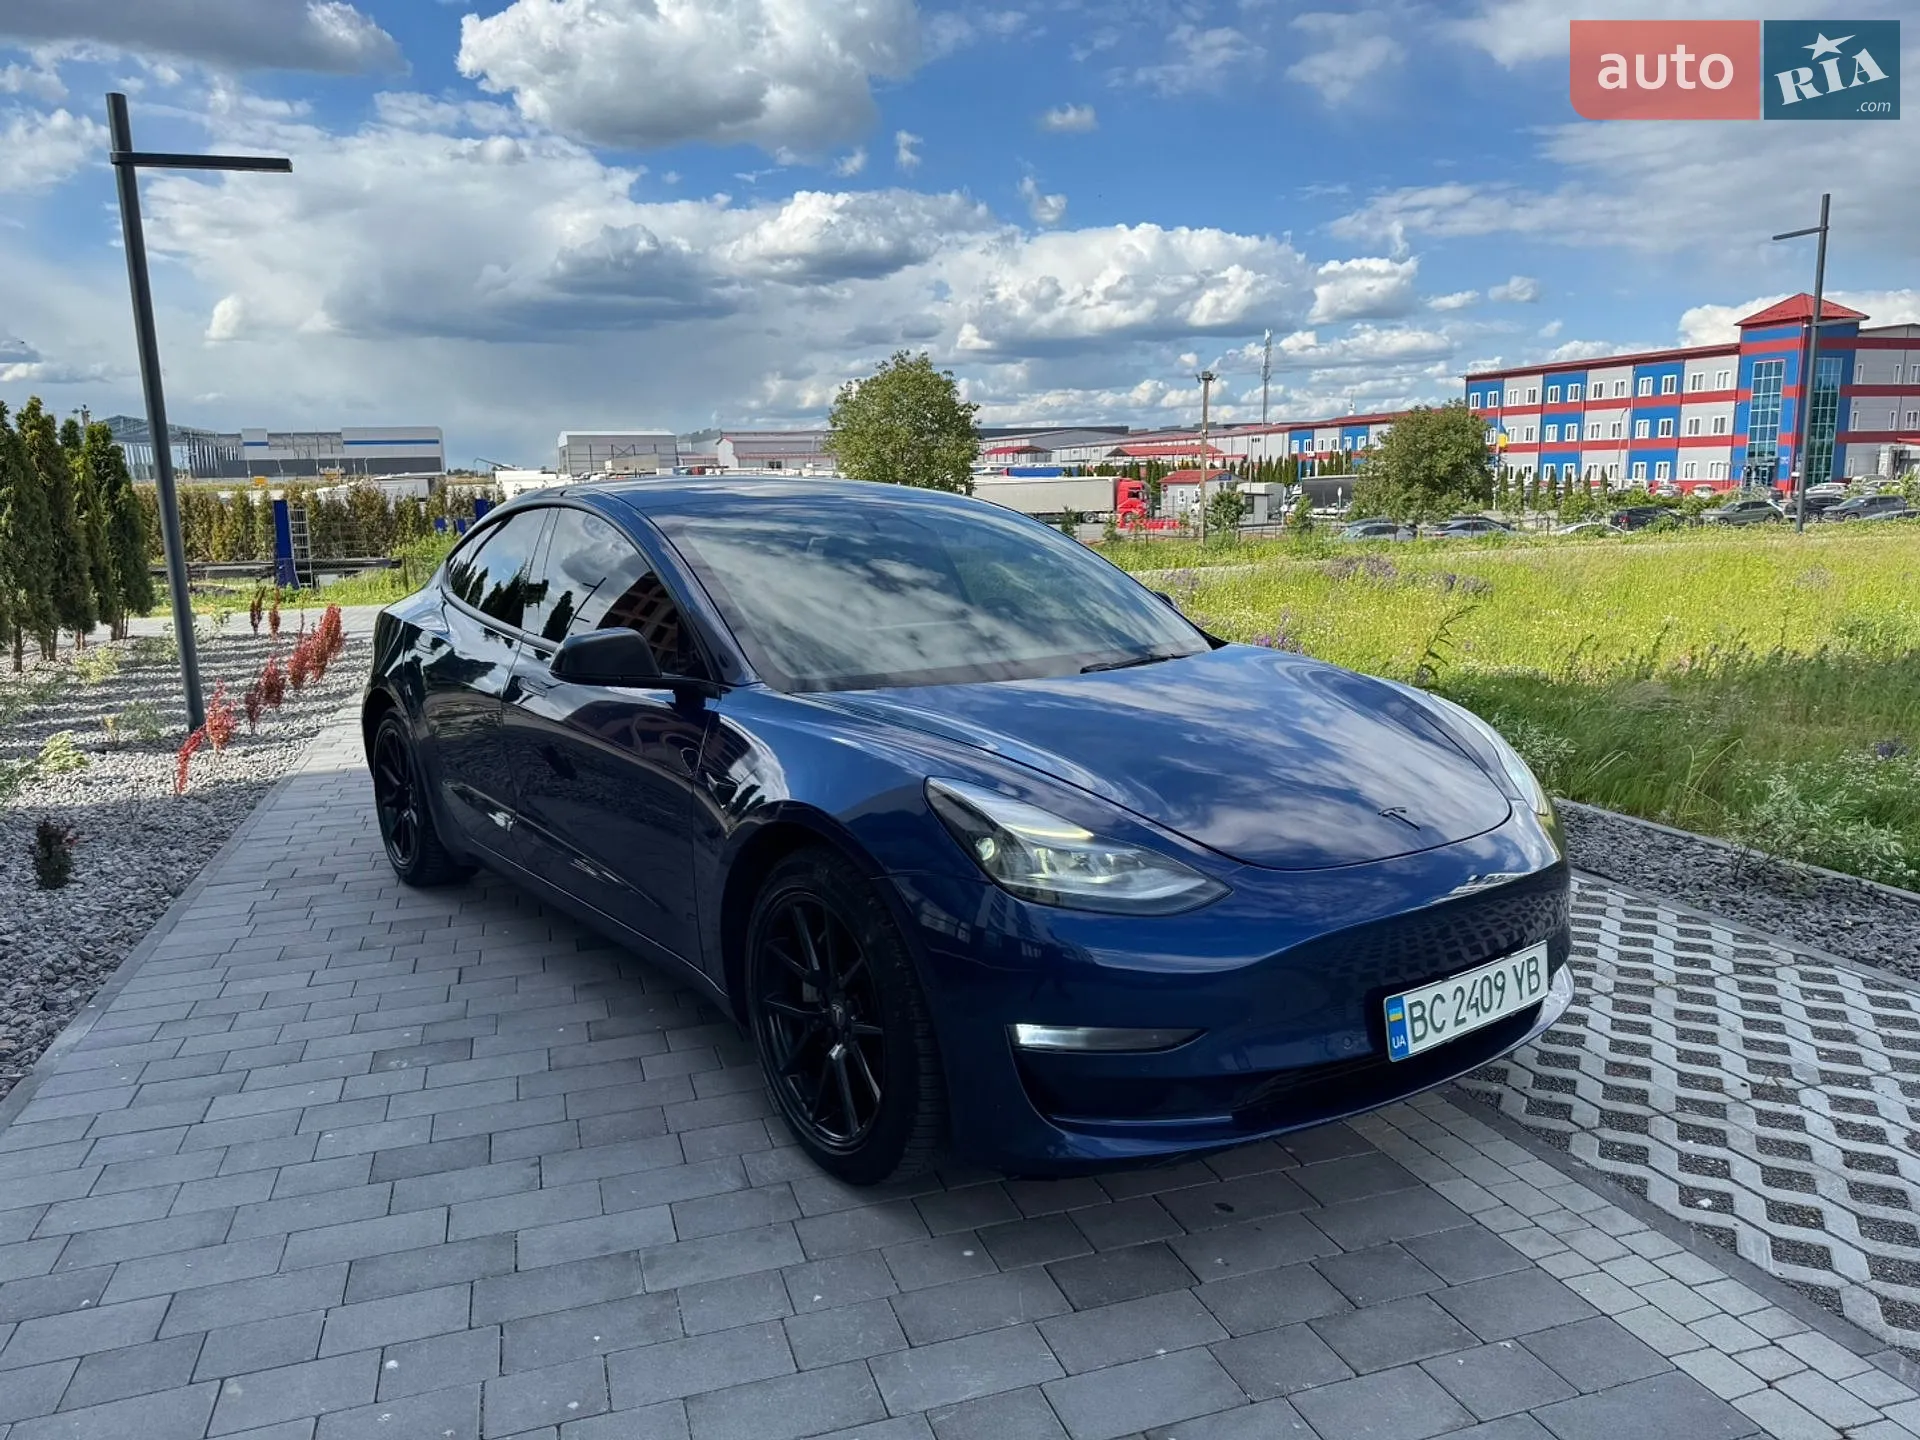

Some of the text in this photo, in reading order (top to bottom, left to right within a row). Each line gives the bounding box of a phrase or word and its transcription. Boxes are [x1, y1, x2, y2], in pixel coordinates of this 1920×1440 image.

[1408, 956, 1541, 1044] BC 2409 YB
[1392, 1035, 1407, 1049] UA
